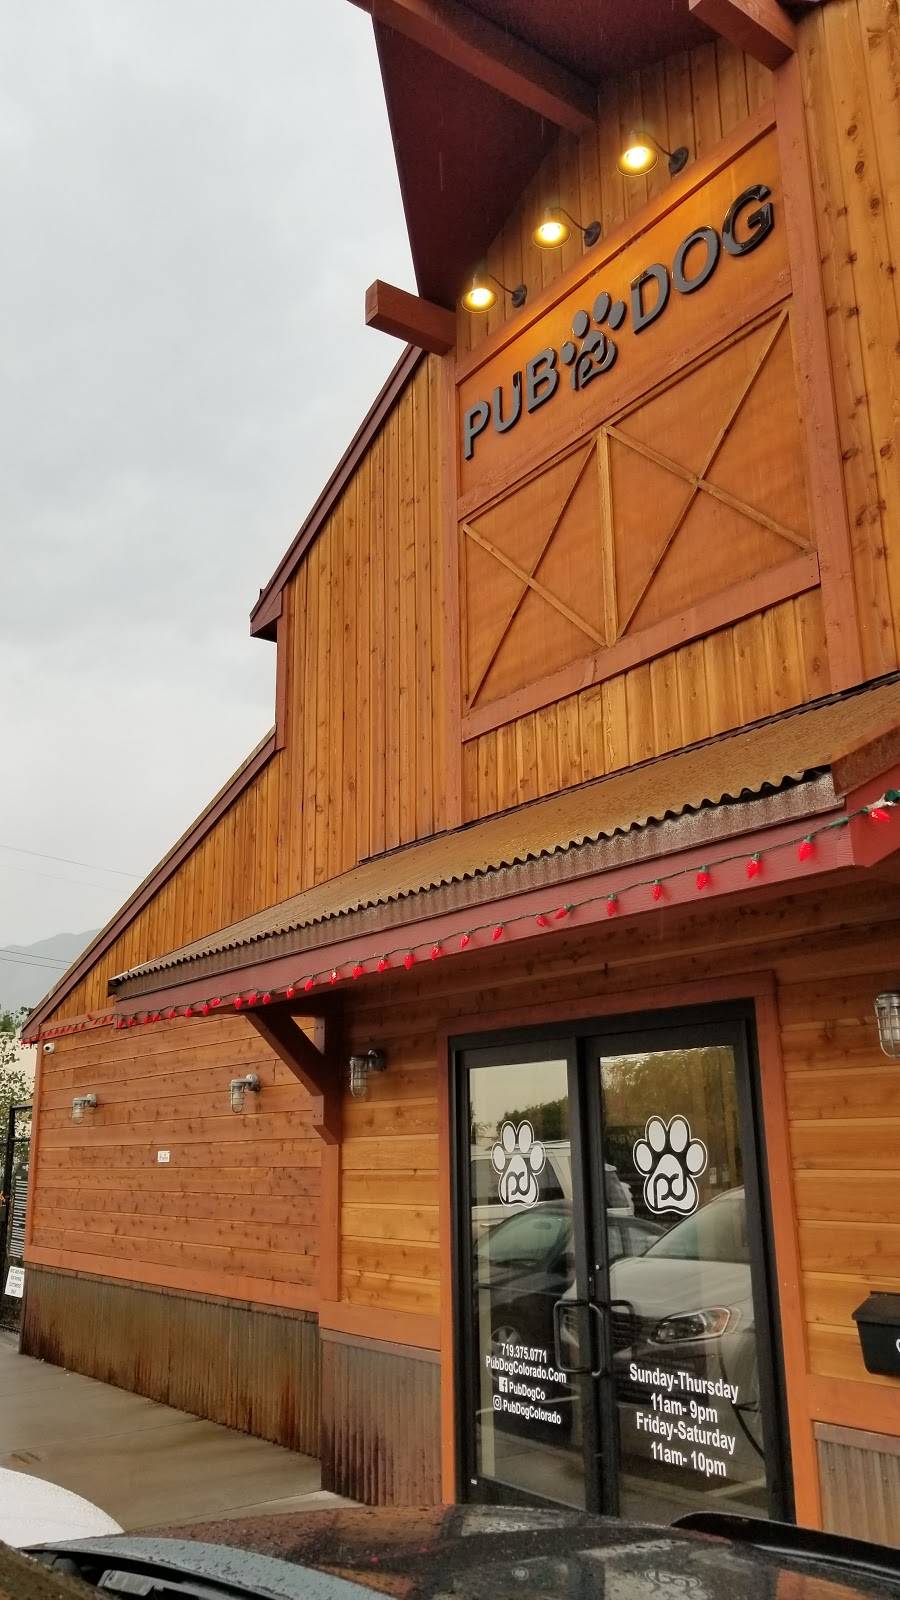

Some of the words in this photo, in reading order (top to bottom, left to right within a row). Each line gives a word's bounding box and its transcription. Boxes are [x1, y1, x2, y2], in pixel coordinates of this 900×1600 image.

[463, 347, 559, 460] PUB
[630, 184, 774, 334] DOG
[501, 1343, 547, 1363] 719.375.0771
[486, 1355, 567, 1383] PubDogColorado.Com
[509, 1381, 546, 1401] PubDogCo
[629, 1363, 739, 1404] Sunday-Thursday
[503, 1399, 562, 1424] PubDogColorado
[689, 1404, 718, 1423] 9pm
[636, 1412, 736, 1455] Friday-Saturday
[690, 1452, 727, 1477] 10pm
